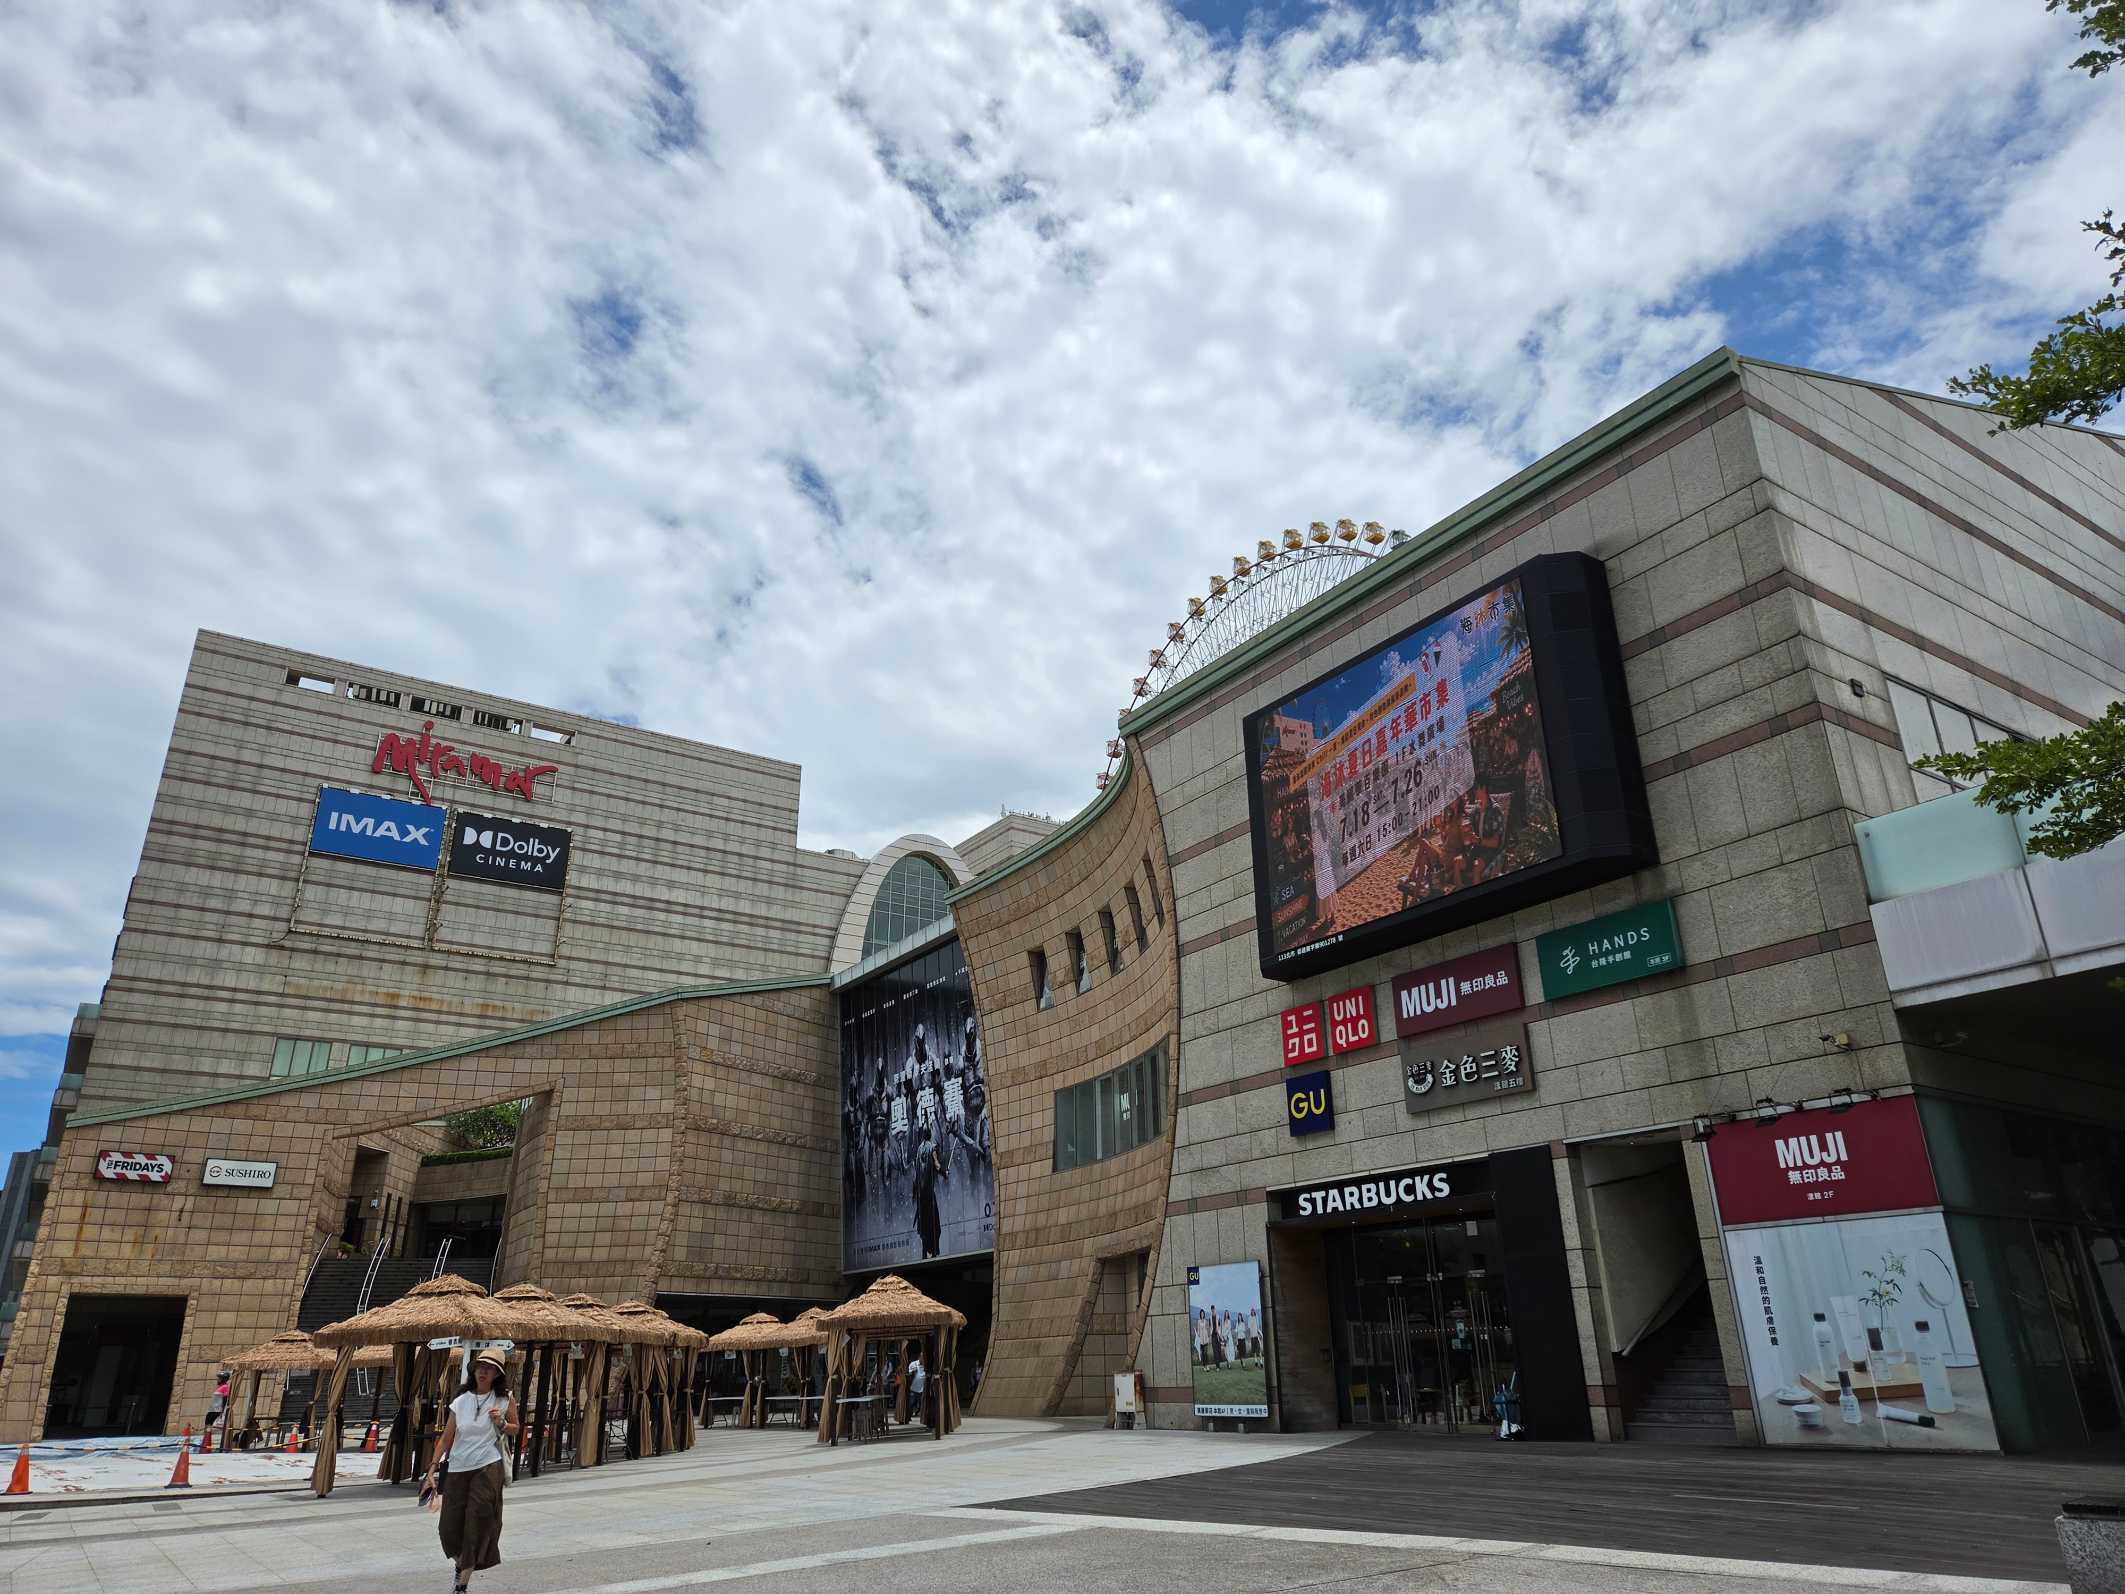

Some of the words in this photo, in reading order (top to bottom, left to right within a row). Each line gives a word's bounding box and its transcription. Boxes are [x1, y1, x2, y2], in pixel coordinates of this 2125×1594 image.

[372, 720, 559, 805] Miramar
[1340, 802, 1371, 843] 7.18
[1391, 762, 1423, 804] 7.26
[328, 811, 431, 846] IMAX
[476, 853, 543, 873] CINEMA
[495, 832, 561, 865] Dolby
[1280, 885, 1295, 900] SEA
[1588, 927, 1651, 955] HANDS
[1333, 994, 1364, 1021] UNI
[1400, 977, 1457, 1020] MUJI
[1459, 971, 1509, 996] 無印良品
[1286, 1009, 1314, 1034] ユニ
[1335, 1018, 1369, 1049] QLO
[1287, 1033, 1317, 1058] クロ
[1438, 1045, 1520, 1088] 金色三麥
[890, 1077, 965, 1135] 奧德賽
[1290, 1089, 1325, 1120] GU
[1774, 1131, 1848, 1169] MUJI
[113, 1160, 164, 1173] FRIDAYS
[224, 1168, 272, 1179] SUSHIRO
[1787, 1166, 1845, 1185] 無印良品
[1298, 1173, 1451, 1216] STARBUCKS
[1189, 1272, 1200, 1281] GU
[1753, 1255, 1779, 1346] 溫和自然的肌膚保養
